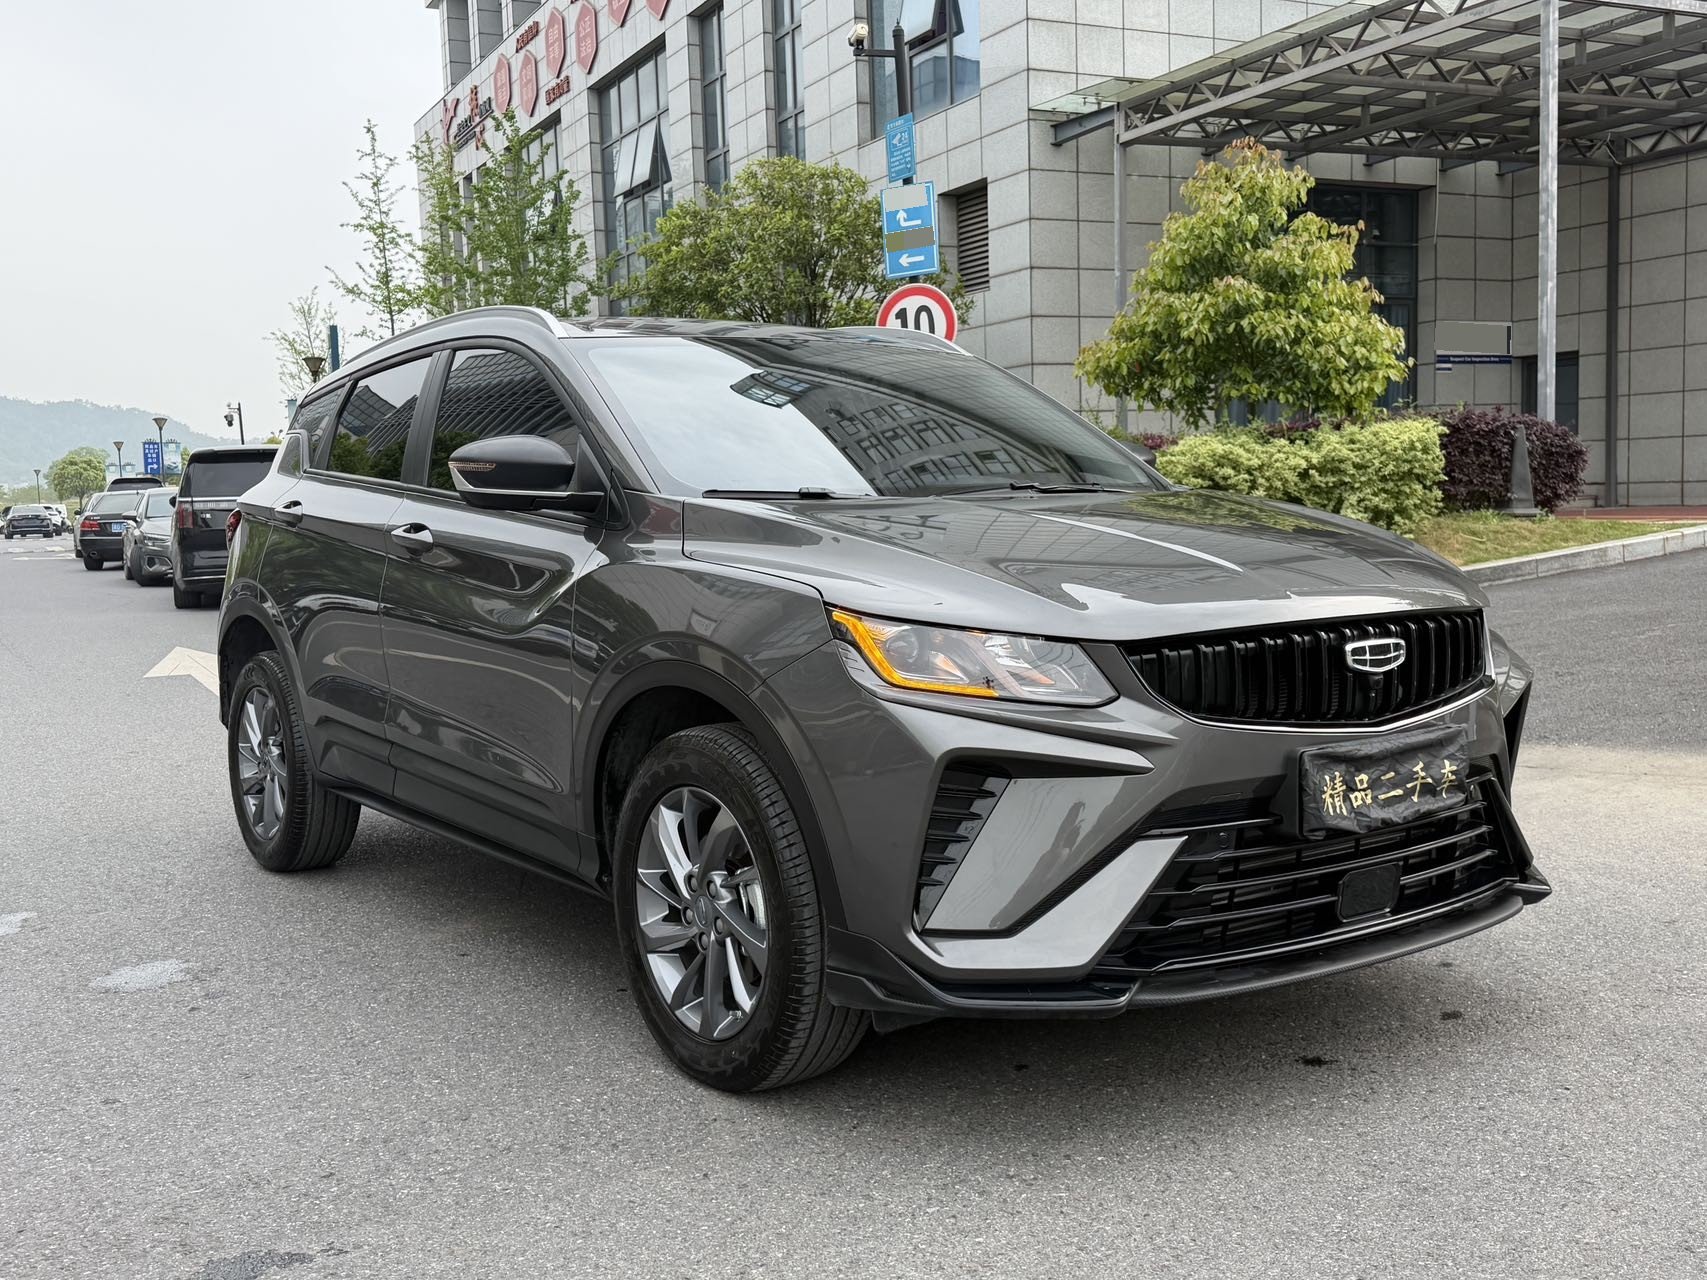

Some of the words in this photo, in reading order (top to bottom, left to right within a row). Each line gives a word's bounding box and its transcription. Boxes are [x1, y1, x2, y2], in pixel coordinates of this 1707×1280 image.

[895, 304, 936, 334] 10
[1322, 759, 1459, 817] 精品二手车
